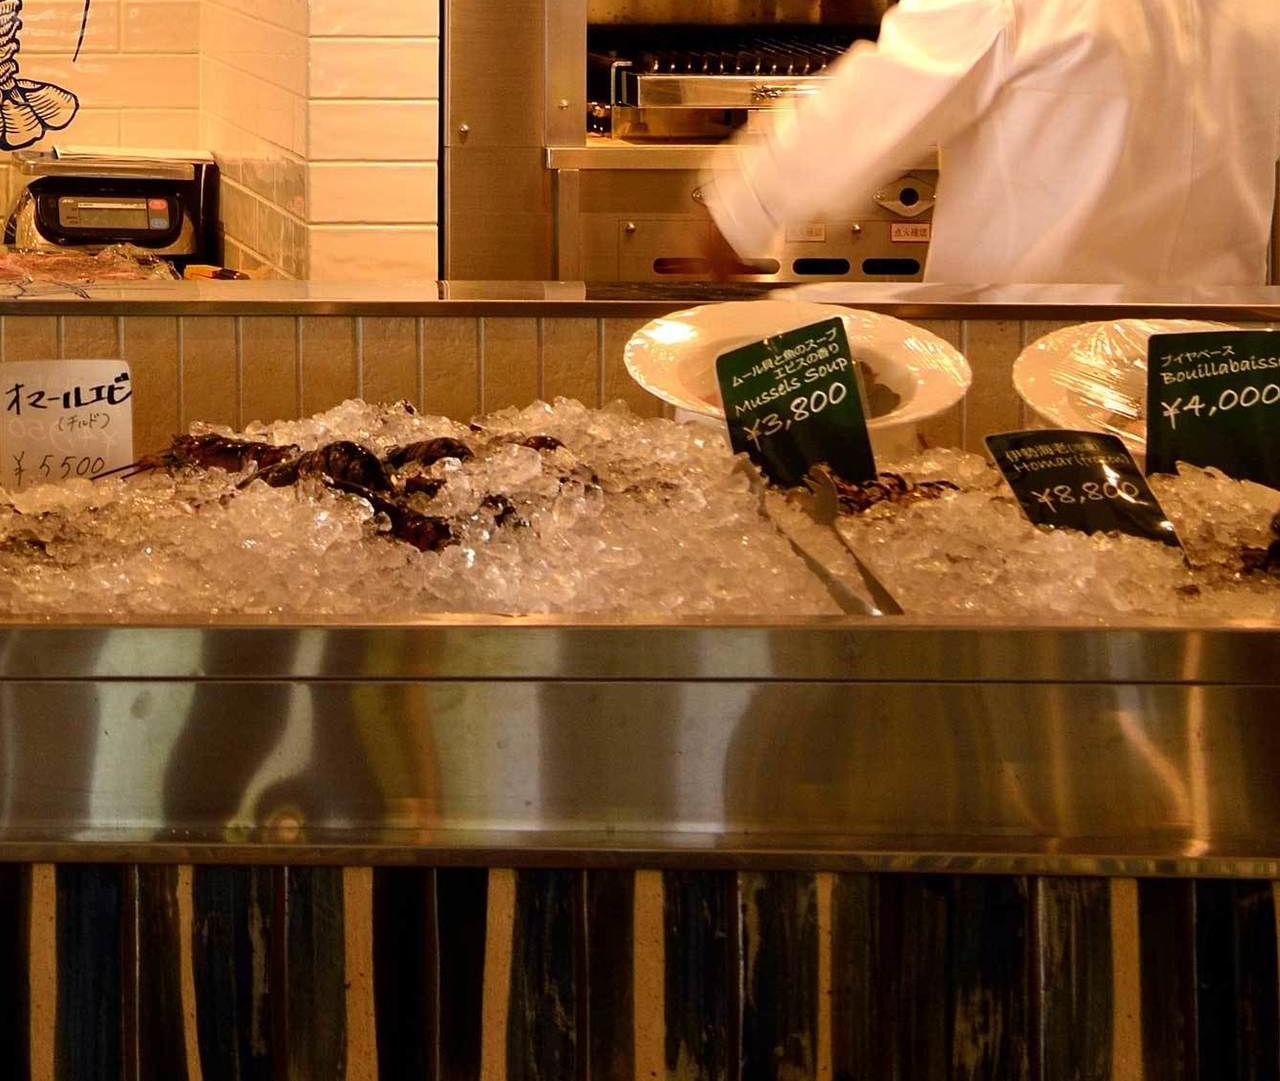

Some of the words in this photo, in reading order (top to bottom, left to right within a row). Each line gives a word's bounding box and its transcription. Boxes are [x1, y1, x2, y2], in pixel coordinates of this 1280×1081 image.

[1160, 356, 1280, 385] Bouillabaiss
[744, 382, 847, 452] ¥3,800
[1160, 384, 1280, 430] ¥4,000
[1030, 481, 1139, 514] ¥8,800
